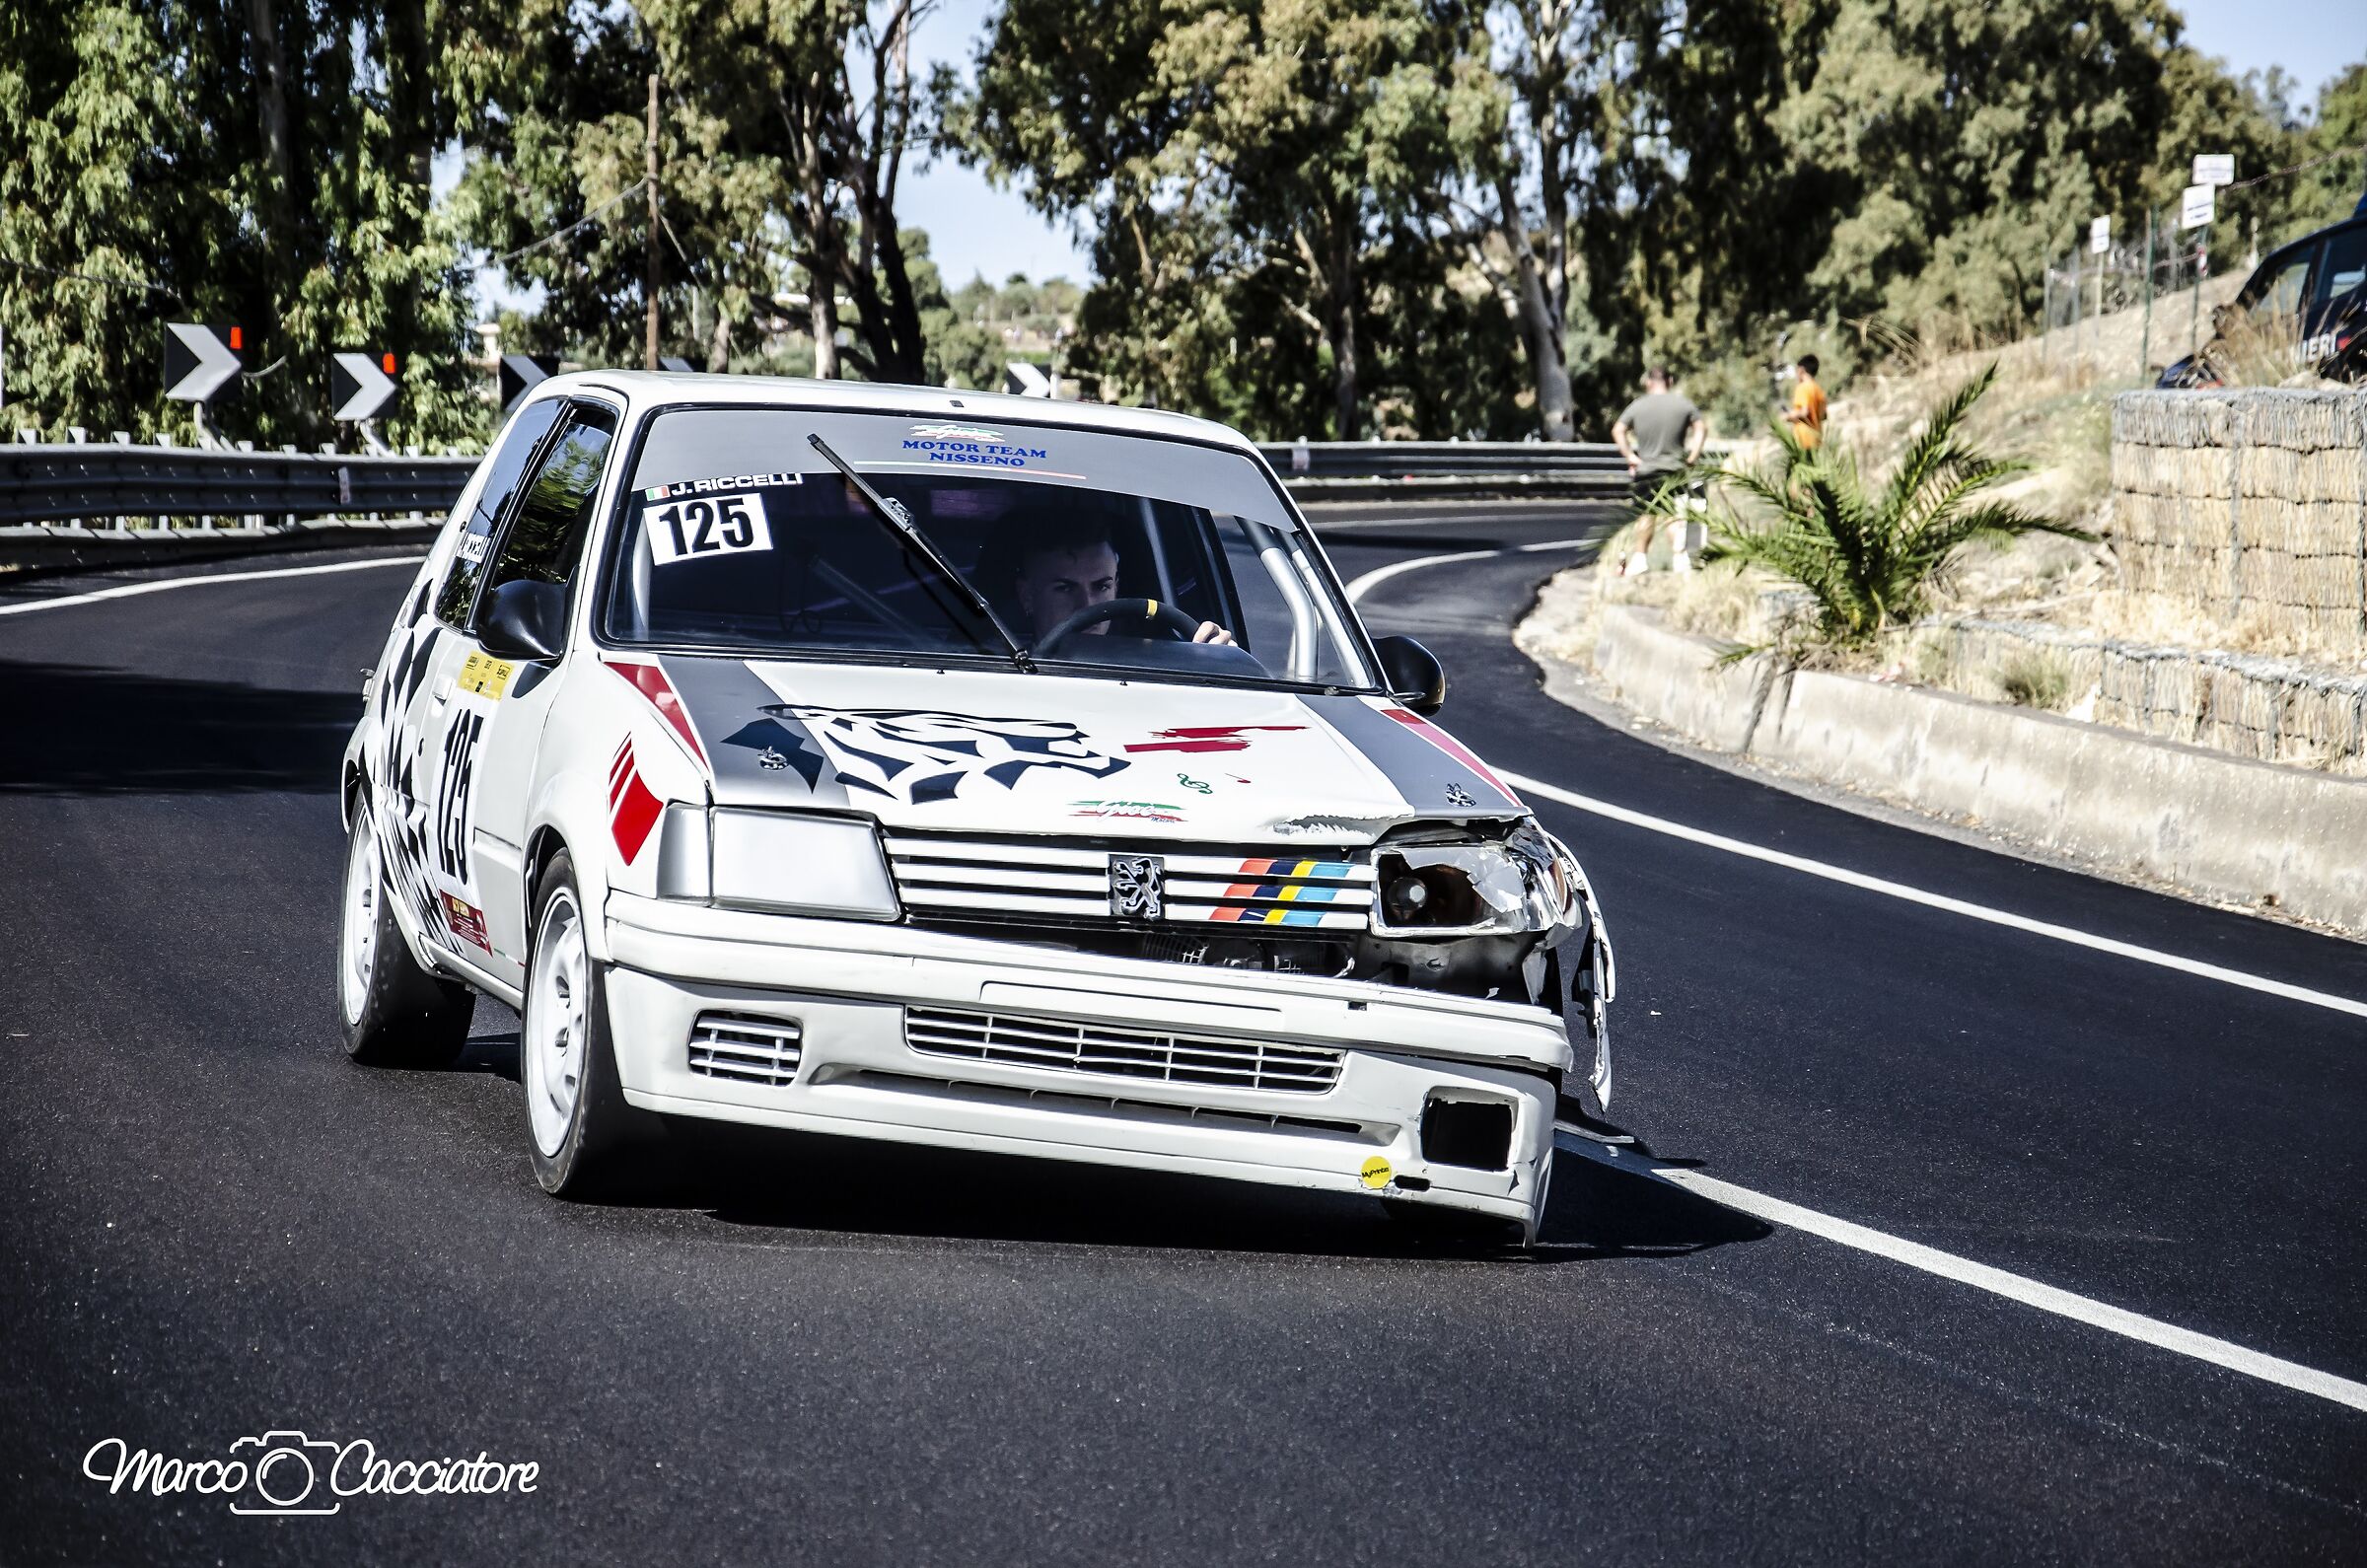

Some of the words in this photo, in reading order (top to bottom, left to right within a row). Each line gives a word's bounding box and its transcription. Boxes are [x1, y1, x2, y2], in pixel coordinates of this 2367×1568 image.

[902, 440, 979, 453] MOTOR
[985, 445, 1046, 459] TEAM
[929, 452, 1025, 466] NISSENO
[659, 497, 754, 556] 125
[437, 708, 484, 886] 125
